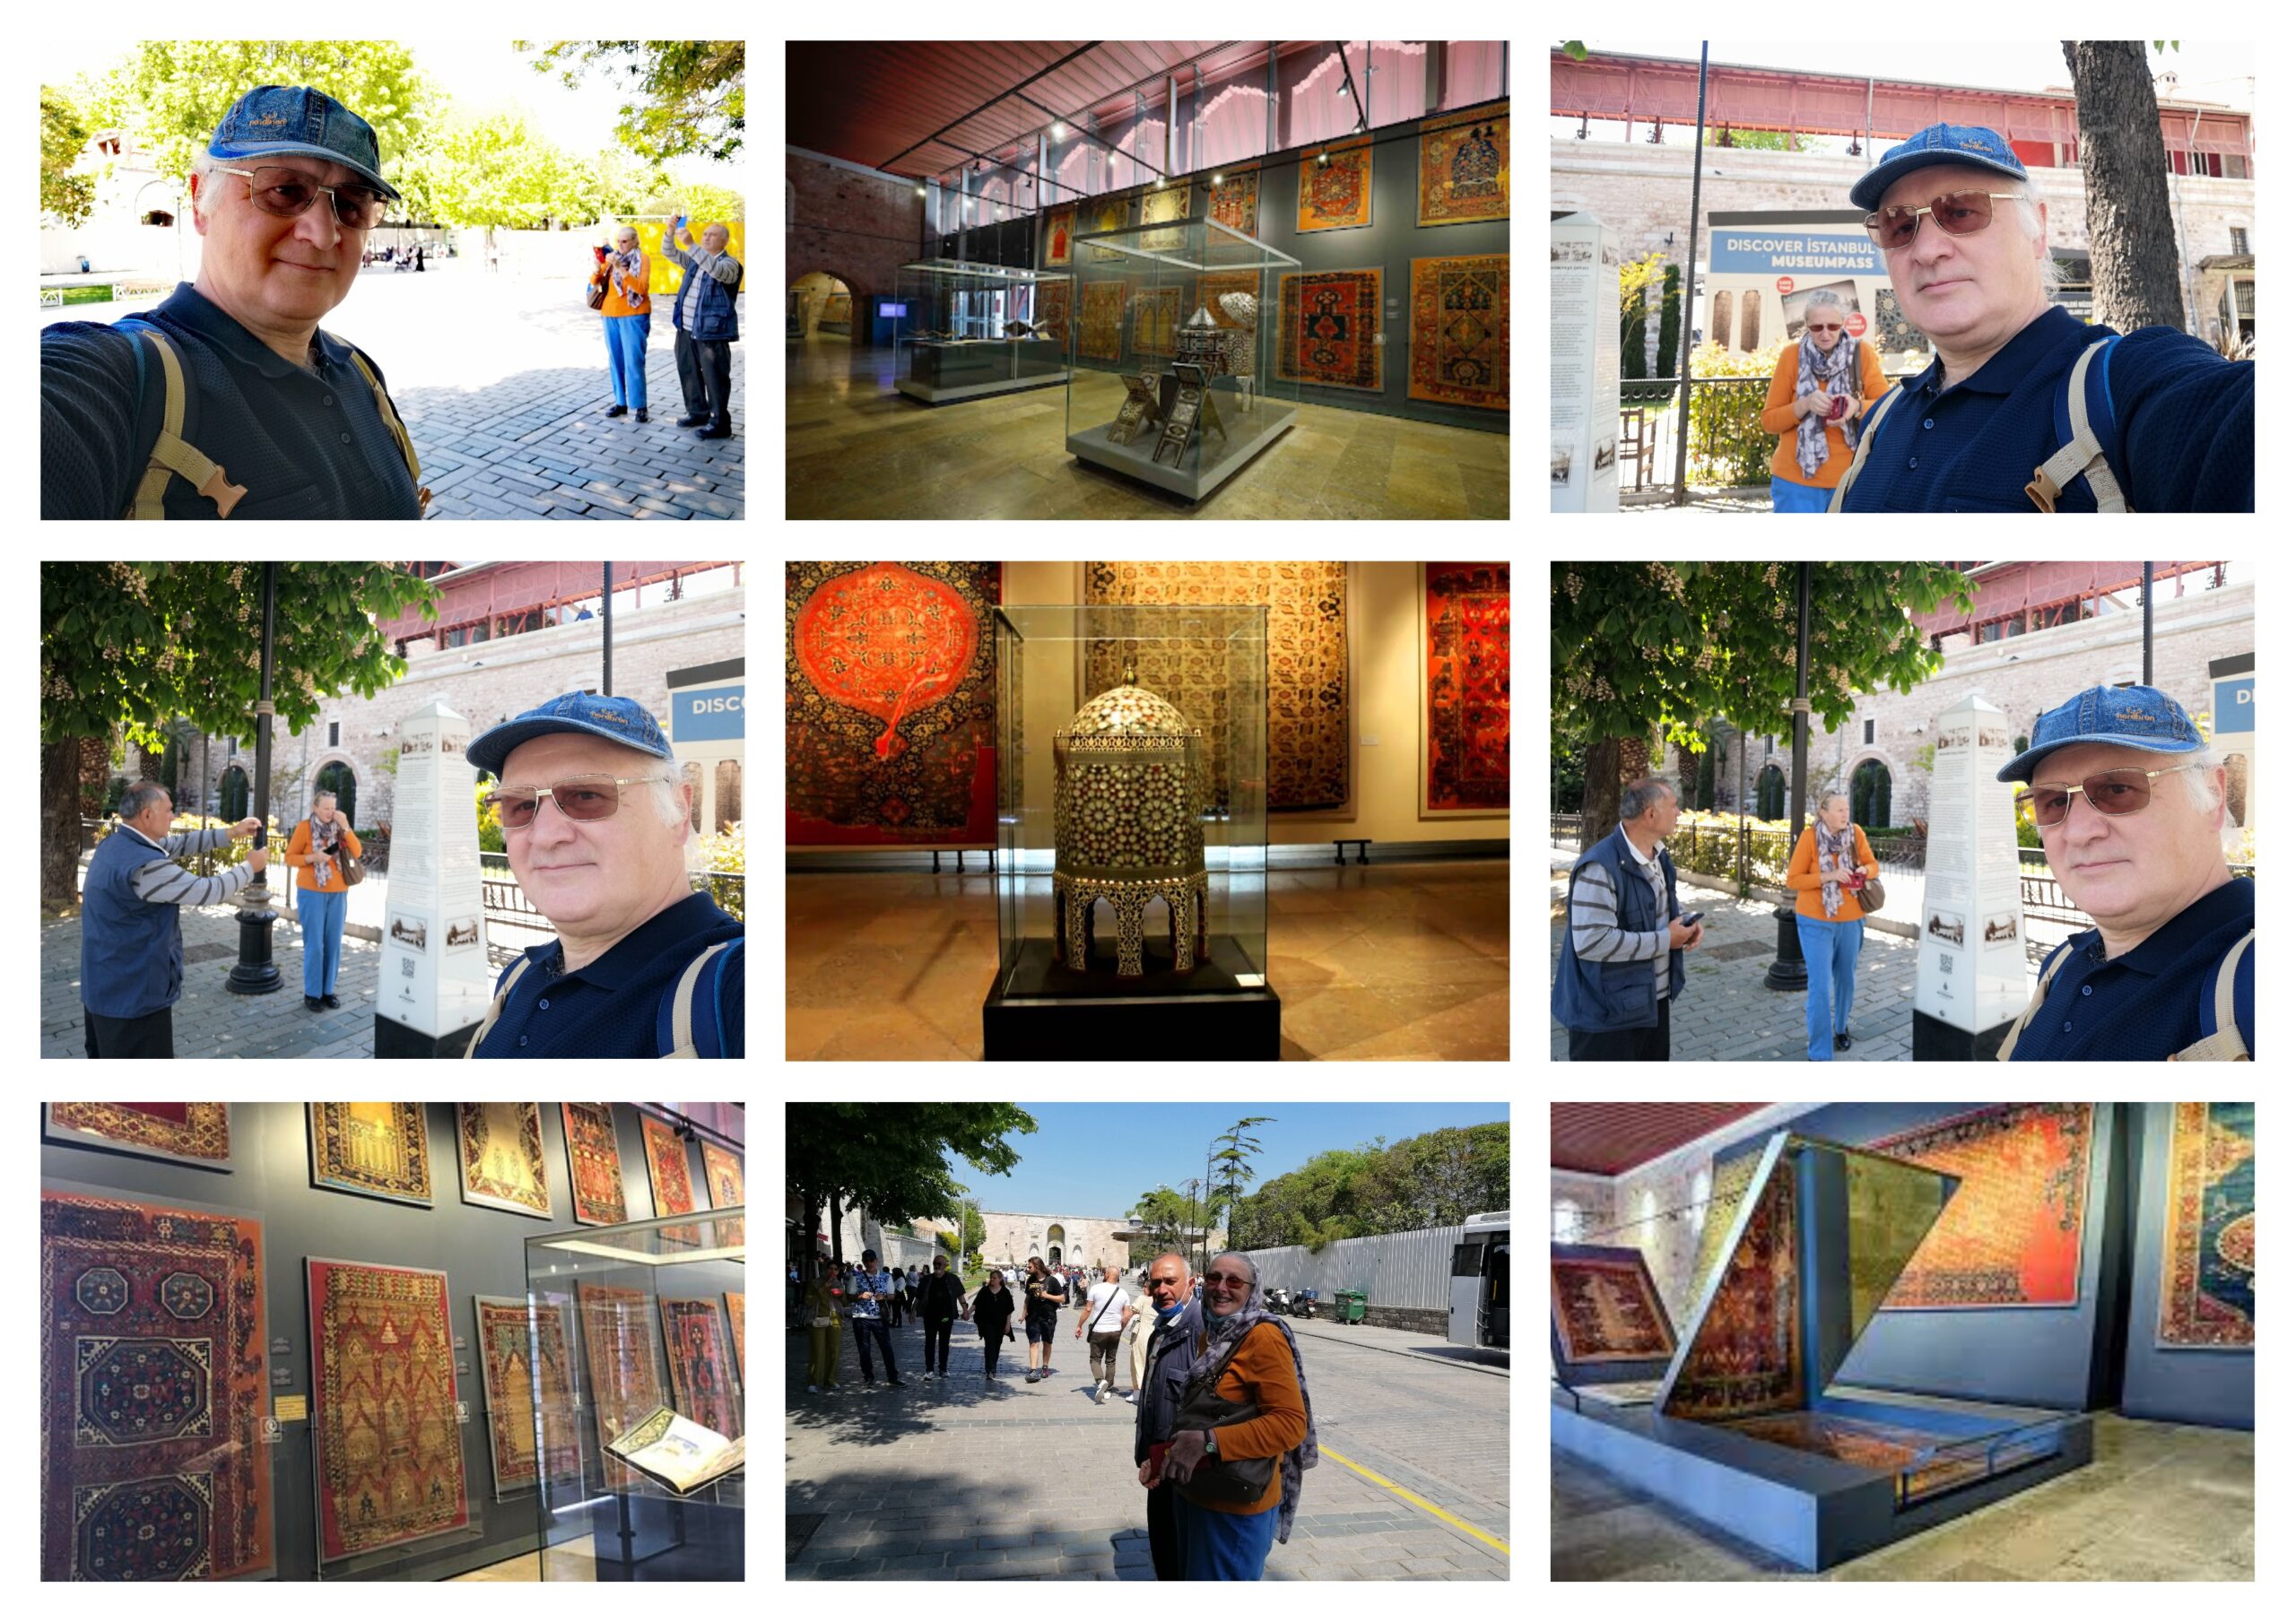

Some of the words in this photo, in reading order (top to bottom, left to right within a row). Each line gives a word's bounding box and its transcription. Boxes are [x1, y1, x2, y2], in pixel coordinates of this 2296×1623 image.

[1727, 239, 1803, 252] DISCOVER
[1807, 238, 1875, 254] İSTANBUL
[1771, 256, 1874, 268] MUSEUMPASS
